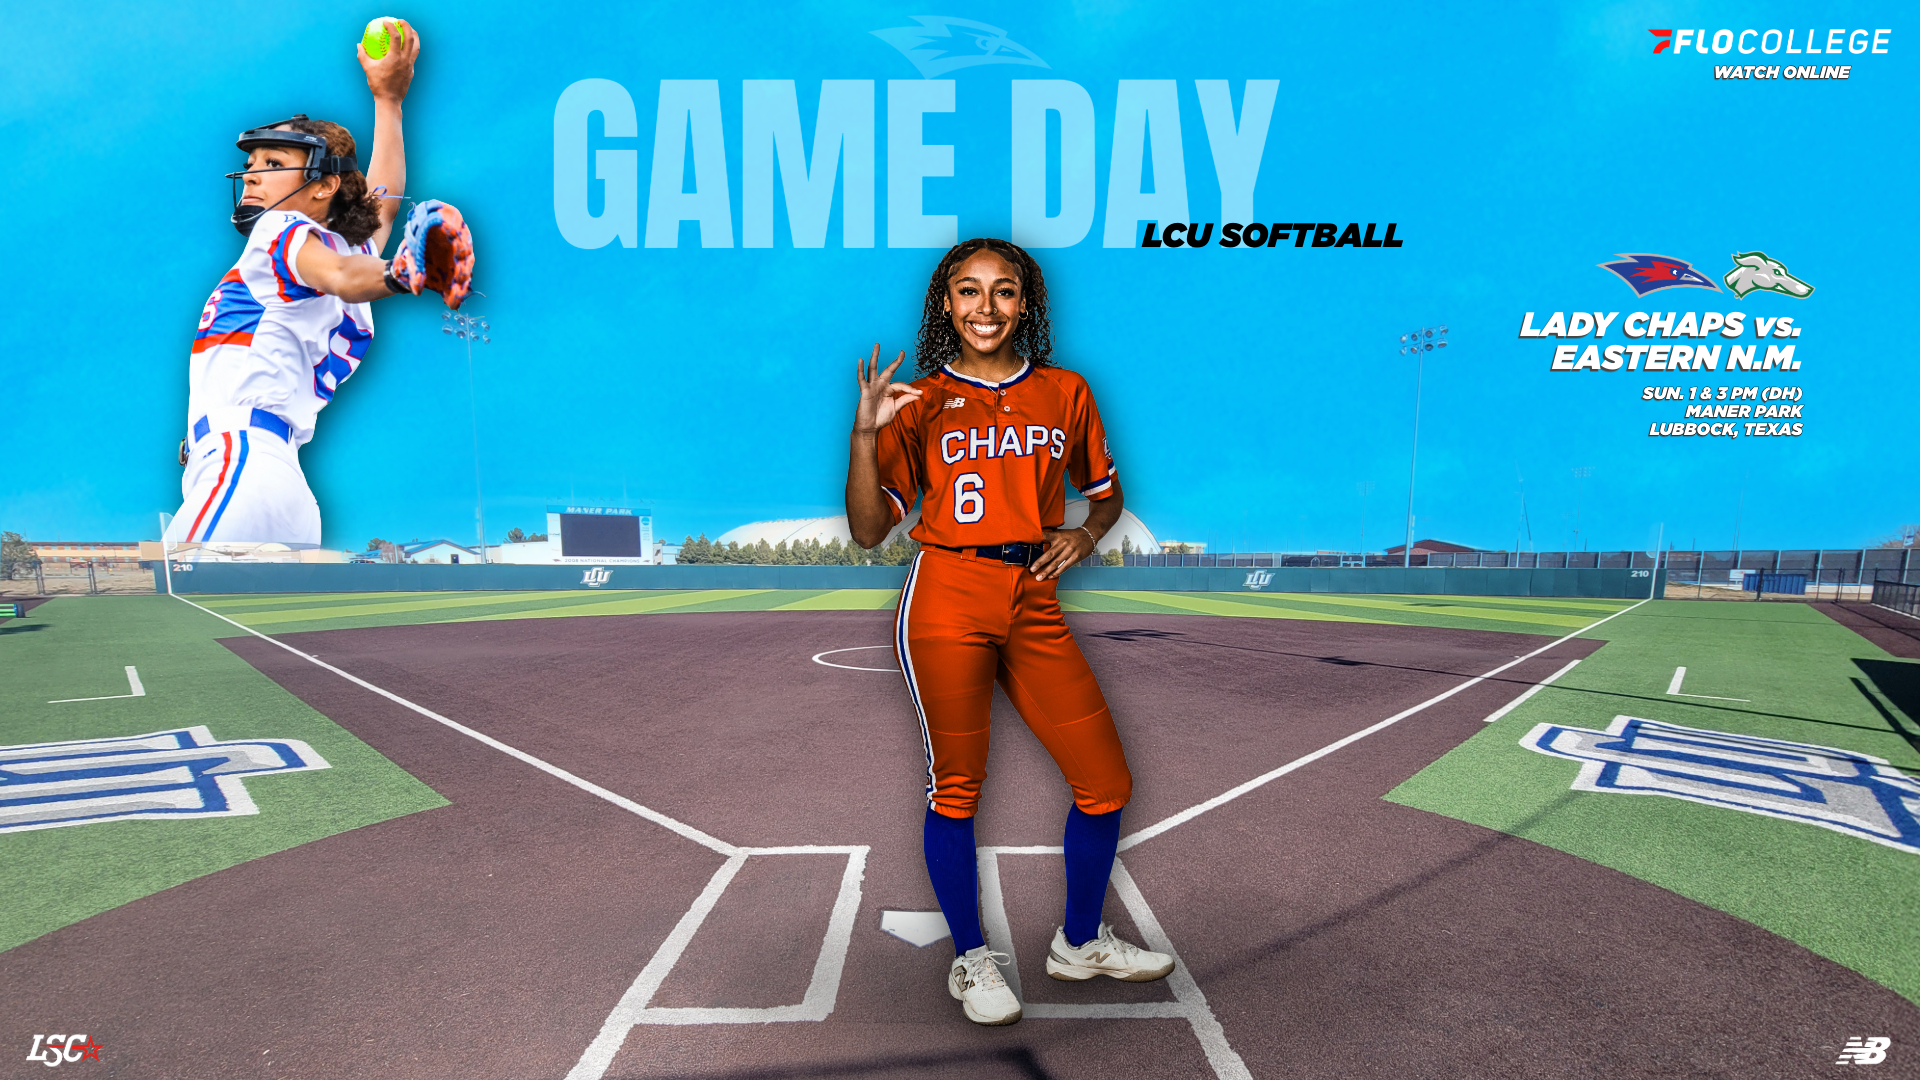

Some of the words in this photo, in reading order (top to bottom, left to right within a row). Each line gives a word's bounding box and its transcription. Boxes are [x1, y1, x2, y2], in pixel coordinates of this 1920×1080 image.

[940, 424, 1067, 466] CHAPS
[953, 471, 985, 525] 6
[172, 563, 194, 572] 210
[1630, 570, 1650, 578] 210
